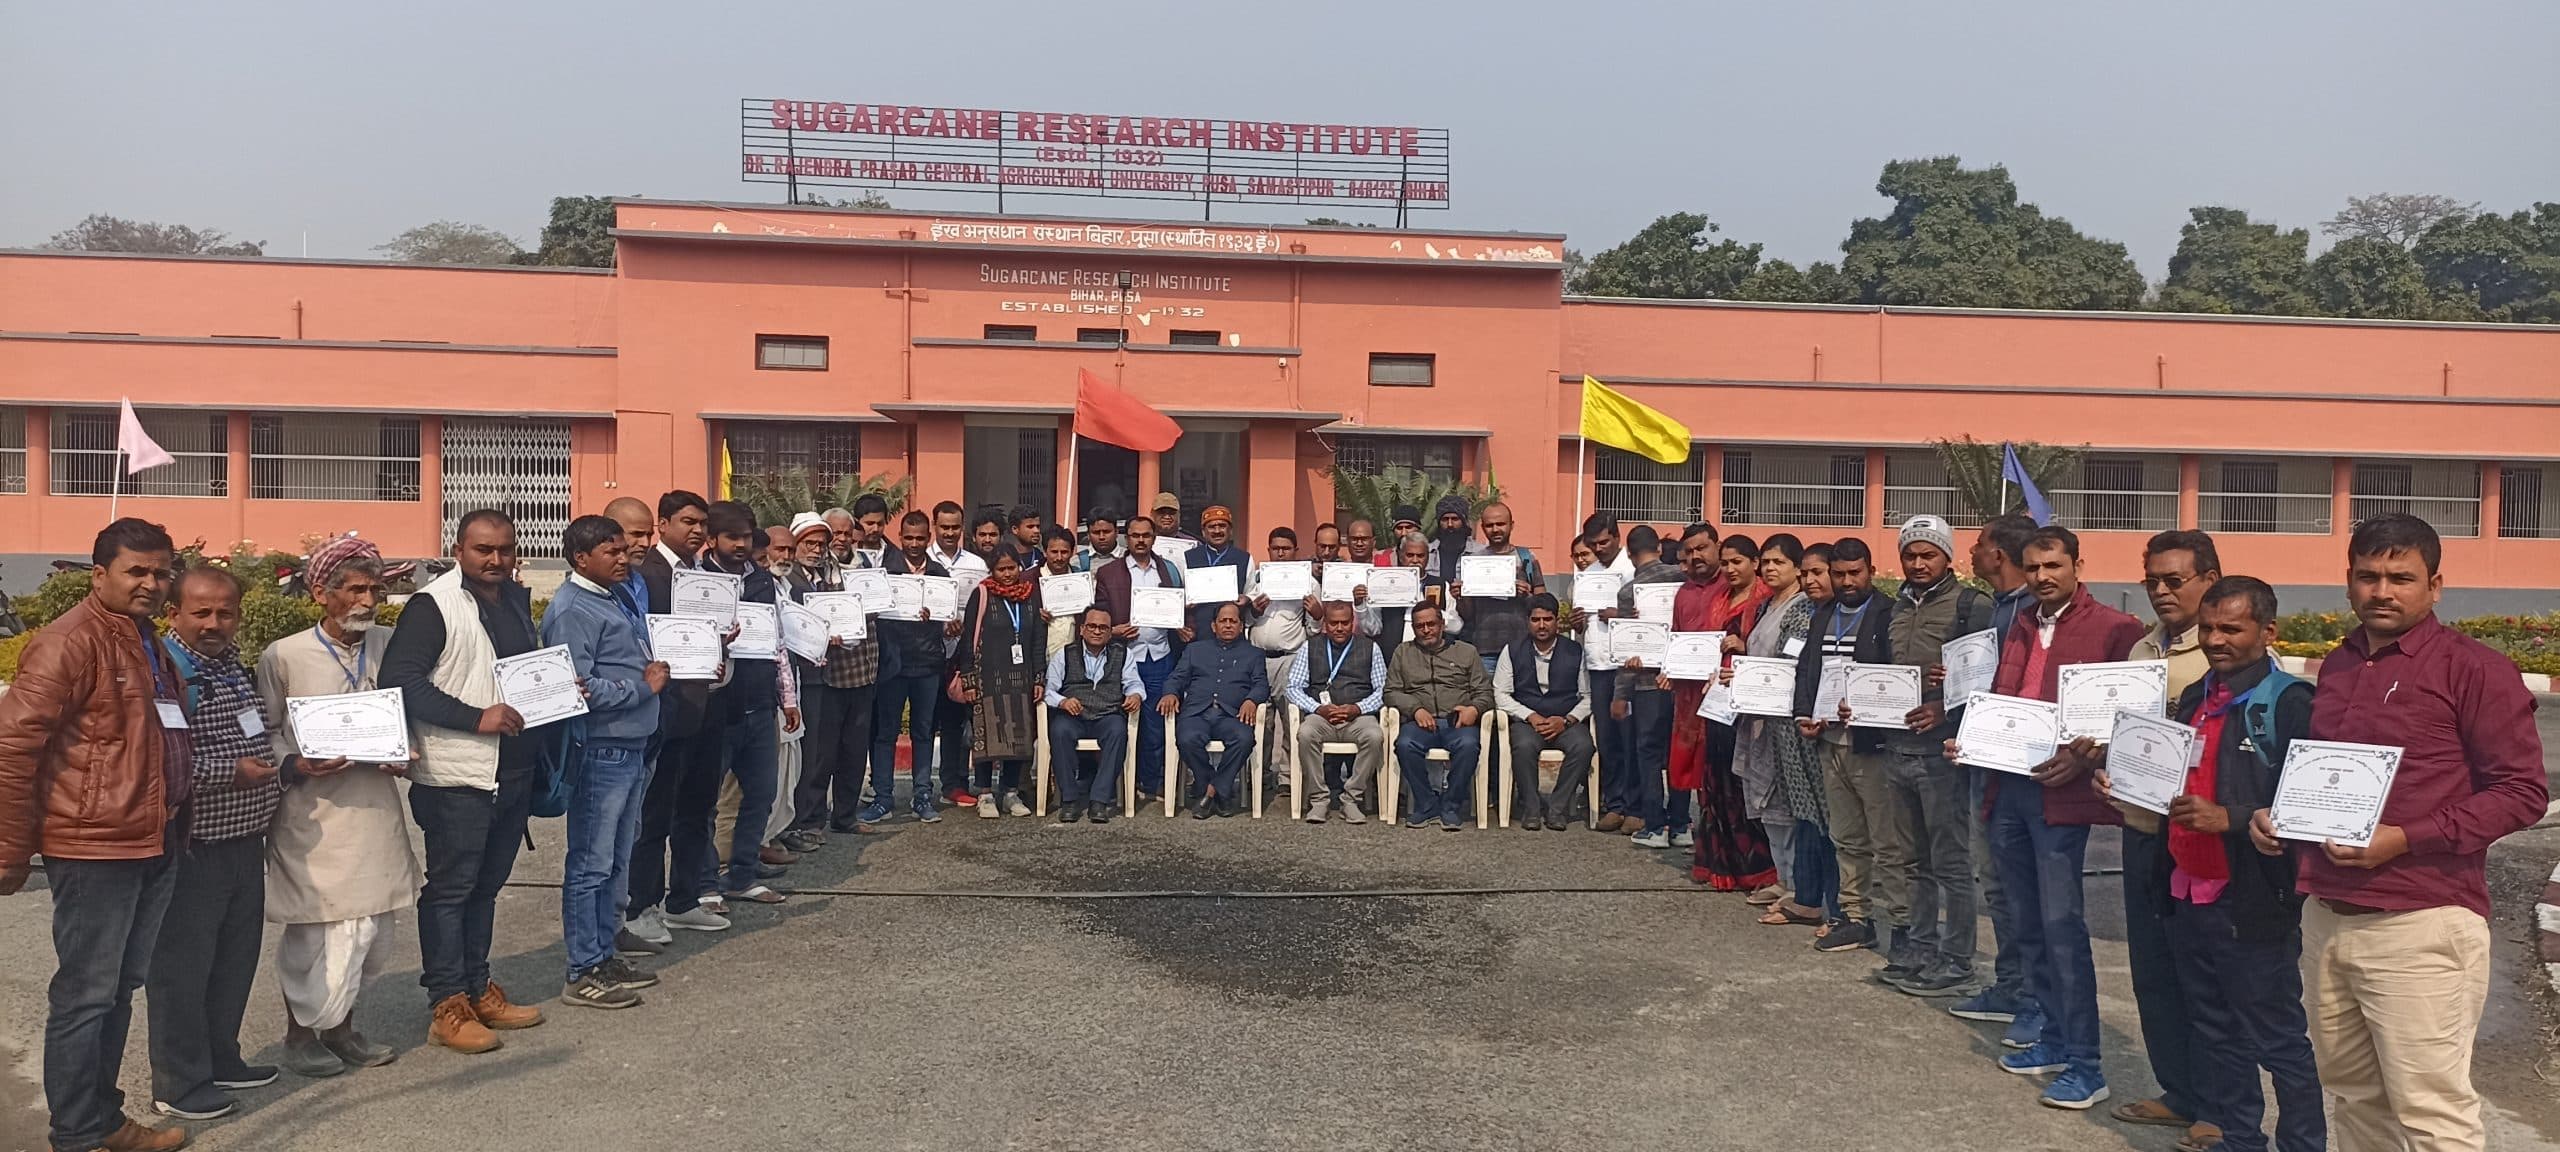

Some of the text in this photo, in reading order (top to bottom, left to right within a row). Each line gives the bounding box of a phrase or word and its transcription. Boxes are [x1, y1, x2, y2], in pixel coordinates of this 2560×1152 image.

[771, 99, 1419, 156] SUGARCANE RESEARCH INSTITUTE
[1112, 148, 1164, 166] 1932)
[774, 155, 853, 177] RAJENDRA
[860, 160, 917, 181] PRASAD
[924, 162, 991, 184] CENTRAL
[998, 166, 1104, 189] AGRICULTURAL
[1110, 170, 1194, 192] UNIVERSITY
[1202, 174, 1237, 194] PUSA
[1247, 176, 1335, 197] SAMASTIPUR
[1073, 268, 1150, 288] RESEACH
